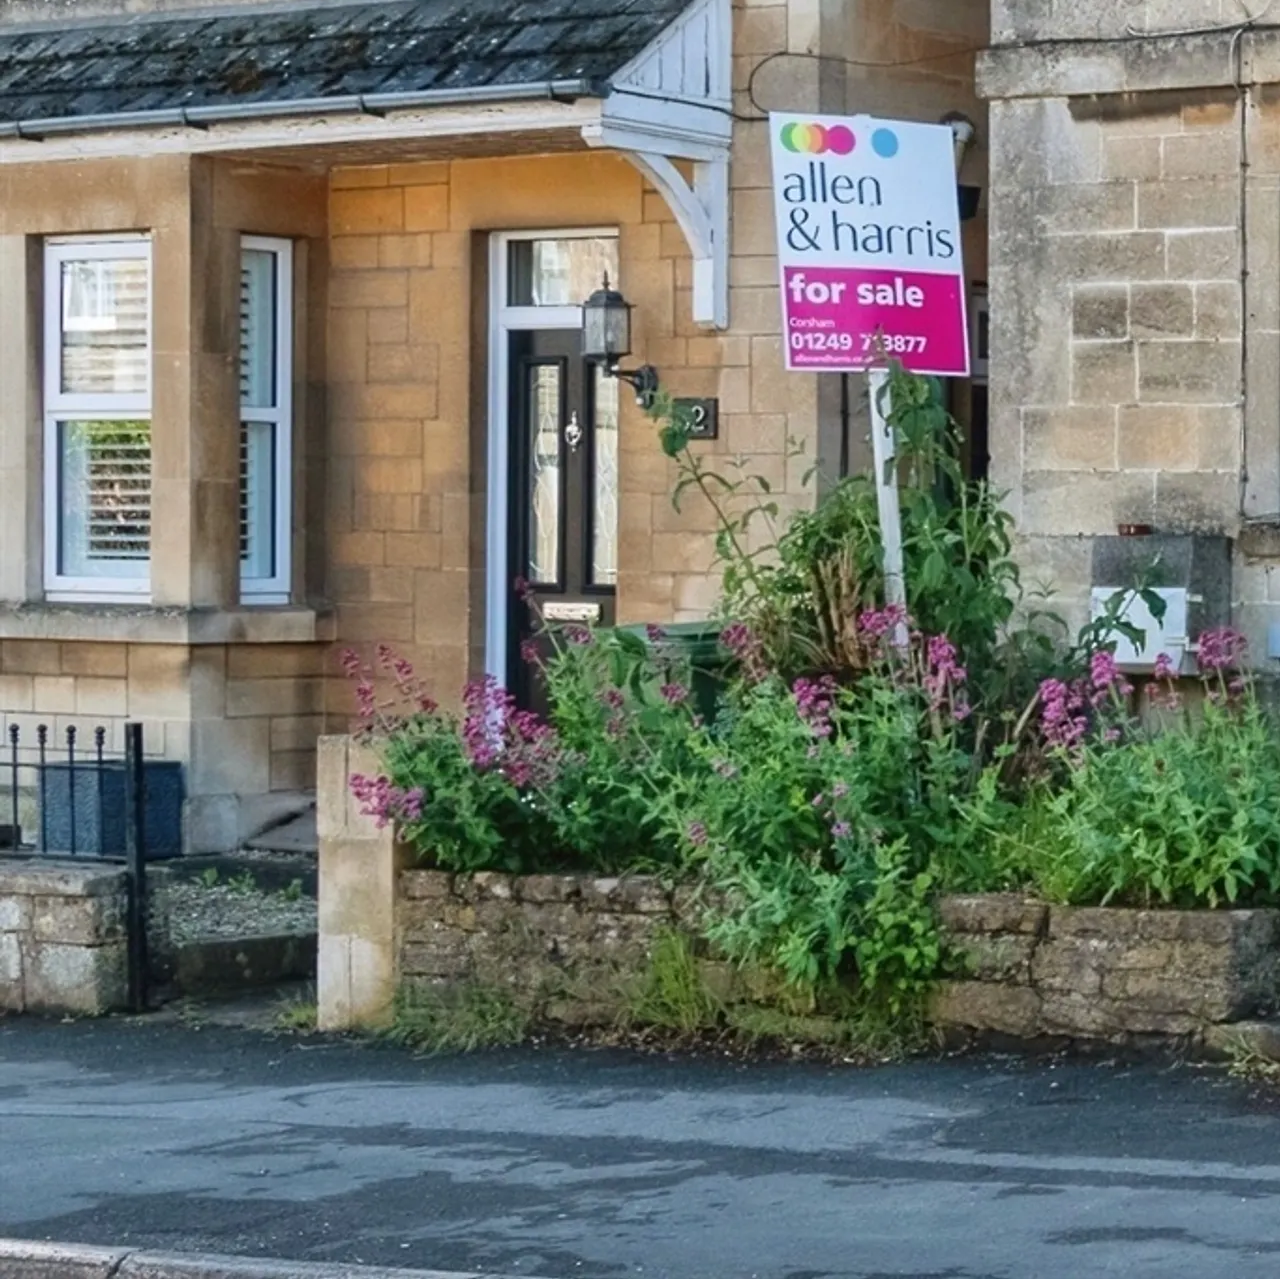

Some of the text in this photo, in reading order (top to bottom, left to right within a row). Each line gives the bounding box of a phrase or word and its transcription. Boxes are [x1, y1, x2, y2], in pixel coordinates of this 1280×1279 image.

[783, 161, 882, 206] allen
[787, 207, 954, 258] & harris
[789, 273, 924, 308] for sale
[790, 317, 835, 328] Corsham
[791, 332, 927, 354] 01249 73877
